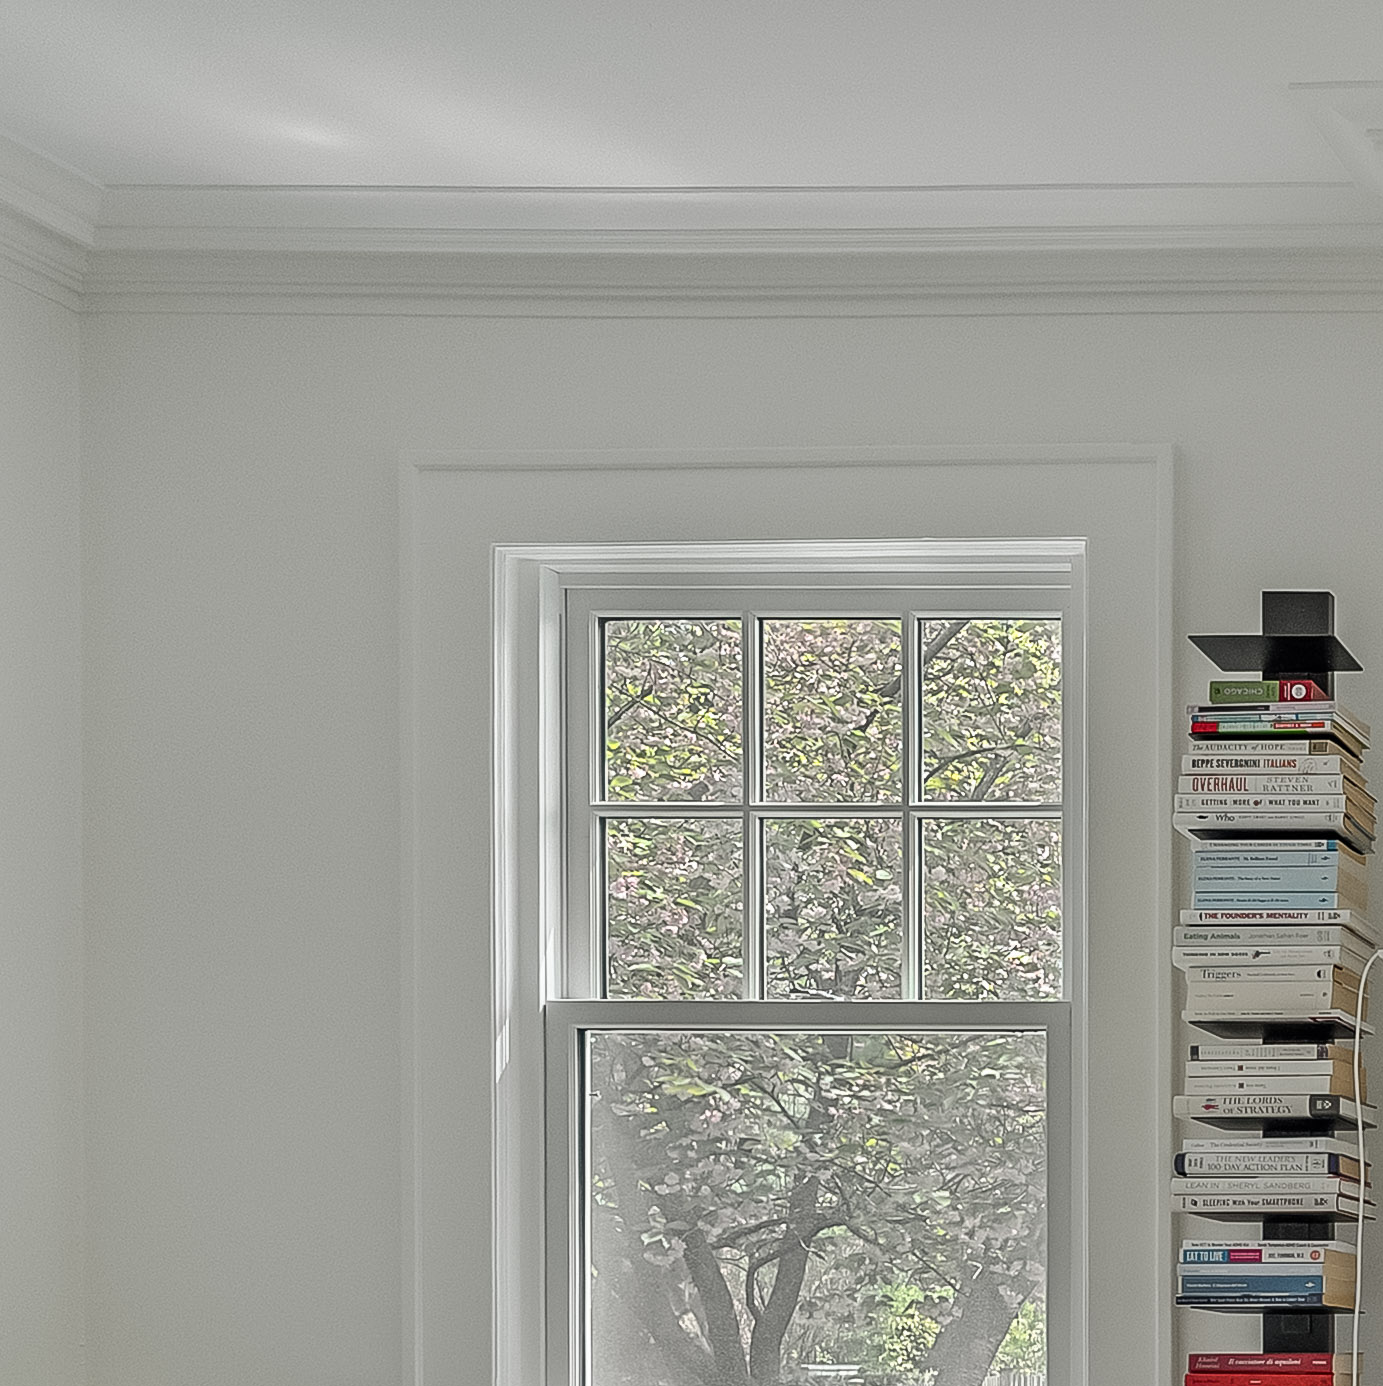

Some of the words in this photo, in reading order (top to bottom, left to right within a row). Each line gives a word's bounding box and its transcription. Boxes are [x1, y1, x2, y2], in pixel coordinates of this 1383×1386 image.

[1223, 687, 1264, 696] CHICAGO
[1205, 743, 1248, 751] AUDACITY
[1260, 743, 1285, 751] HOPE
[1191, 758, 1215, 769] BEPPE
[1215, 758, 1261, 769] SEVERGNINI
[1262, 758, 1297, 769] ITALIANS
[1191, 776, 1249, 793] OVERHAUL
[1266, 776, 1310, 784] STEVEN
[1262, 784, 1314, 793] RATTNER
[1201, 798, 1228, 807] GETTING
[1232, 798, 1250, 807] MORE
[1268, 798, 1287, 807] WHAT
[1287, 798, 1301, 807] YOU
[1302, 798, 1320, 807] WANT
[1215, 813, 1236, 822] Who
[1204, 912, 1219, 920] THE
[1220, 912, 1264, 920] FOUNDER'S
[1266, 912, 1309, 920] MENTALITY
[1183, 932, 1209, 941] Eating
[1210, 932, 1241, 940] Animals
[1201, 969, 1242, 981] Triggers
[1222, 1096, 1242, 1105] THE
[1246, 1096, 1283, 1105] LORDS
[1236, 1106, 1293, 1115] STRATEGY
[1215, 1155, 1235, 1163] THE
[1236, 1155, 1256, 1163] NEW
[1243, 1163, 1278, 1172] ACTION
[1280, 1163, 1303, 1172] PLAN
[1185, 1182, 1208, 1190] LEAN
[1210, 1182, 1220, 1190] IN
[1227, 1182, 1262, 1190] SHERYL
[1263, 1182, 1312, 1190] SANDBERG
[1202, 1198, 1230, 1207] SLEEPING
[1262, 1198, 1304, 1207] SMARTPHONE
[1186, 1250, 1199, 1261] EAT
[1200, 1250, 1209, 1261] TO
[1209, 1250, 1224, 1261] LIVE
